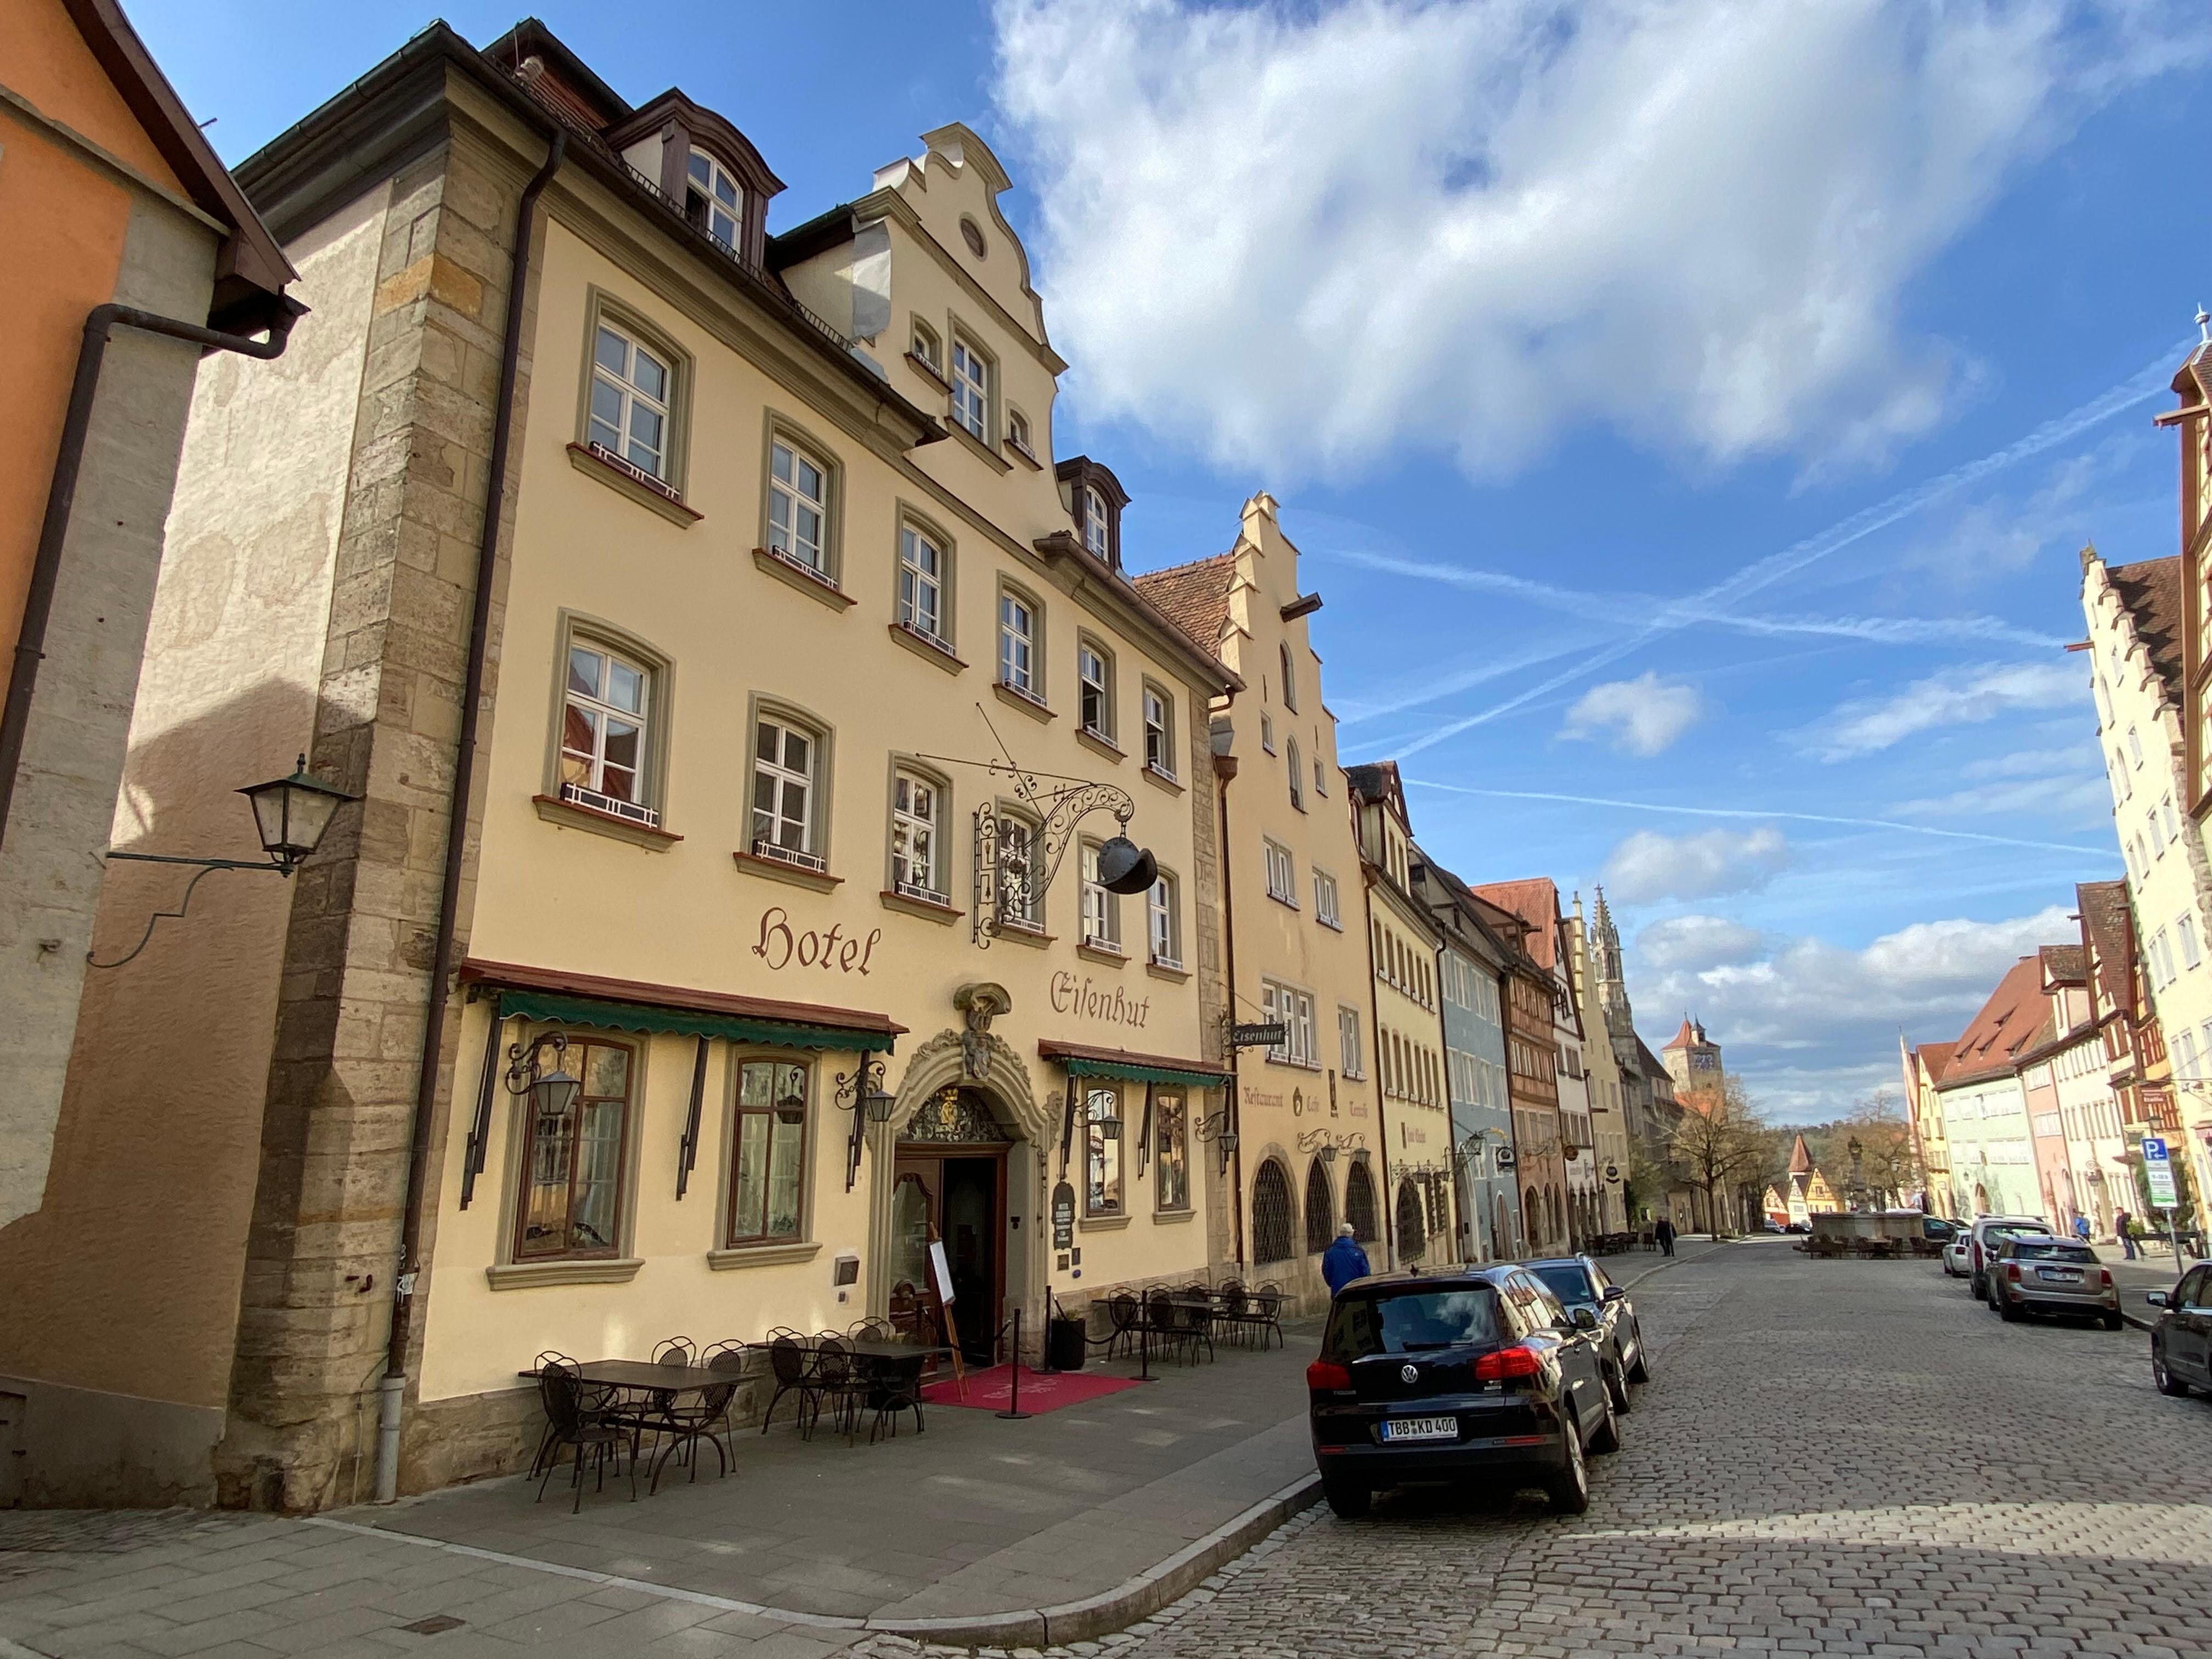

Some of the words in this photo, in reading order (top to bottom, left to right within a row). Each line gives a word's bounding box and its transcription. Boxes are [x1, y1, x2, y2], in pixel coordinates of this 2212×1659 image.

[752, 907, 881, 975] Hotel
[1233, 1029, 1282, 1042] Eisenhut
[2145, 1141, 2159, 1159] P
[1389, 1421, 1410, 1435] TBB
[1417, 1420, 1432, 1434] KD
[1435, 1418, 1455, 1432] 400
